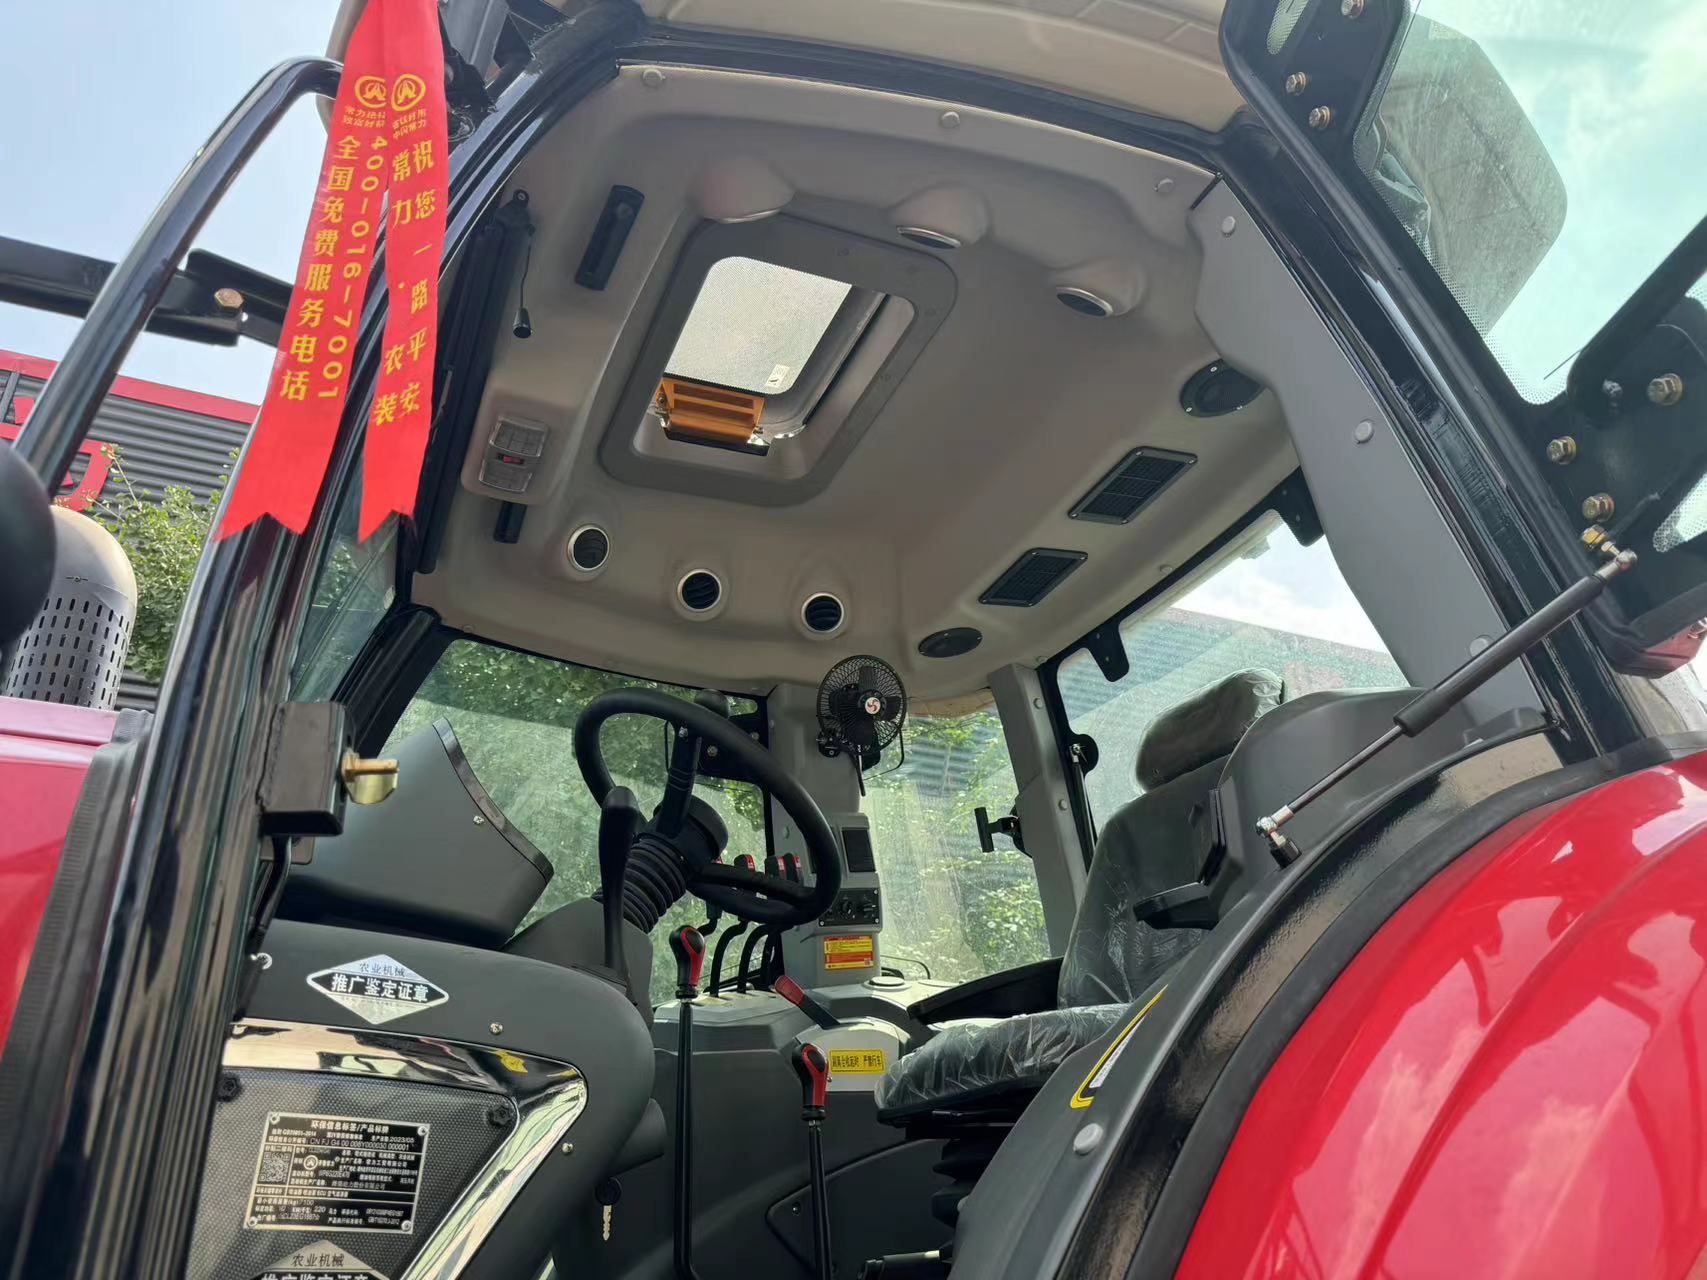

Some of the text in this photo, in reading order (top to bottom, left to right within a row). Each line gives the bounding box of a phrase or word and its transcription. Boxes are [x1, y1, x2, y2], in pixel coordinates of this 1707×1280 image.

[280, 135, 361, 400] 全国免费服务电话
[318, 135, 388, 398] 400-016-7001
[400, 140, 437, 413] 祝您一路平安
[360, 962, 406, 978] 农业机械
[331, 973, 429, 1002] 推广鉴定证章
[311, 1119, 389, 1134] 环保信息标签/产品标牌
[290, 1253, 345, 1268] 农业机械
